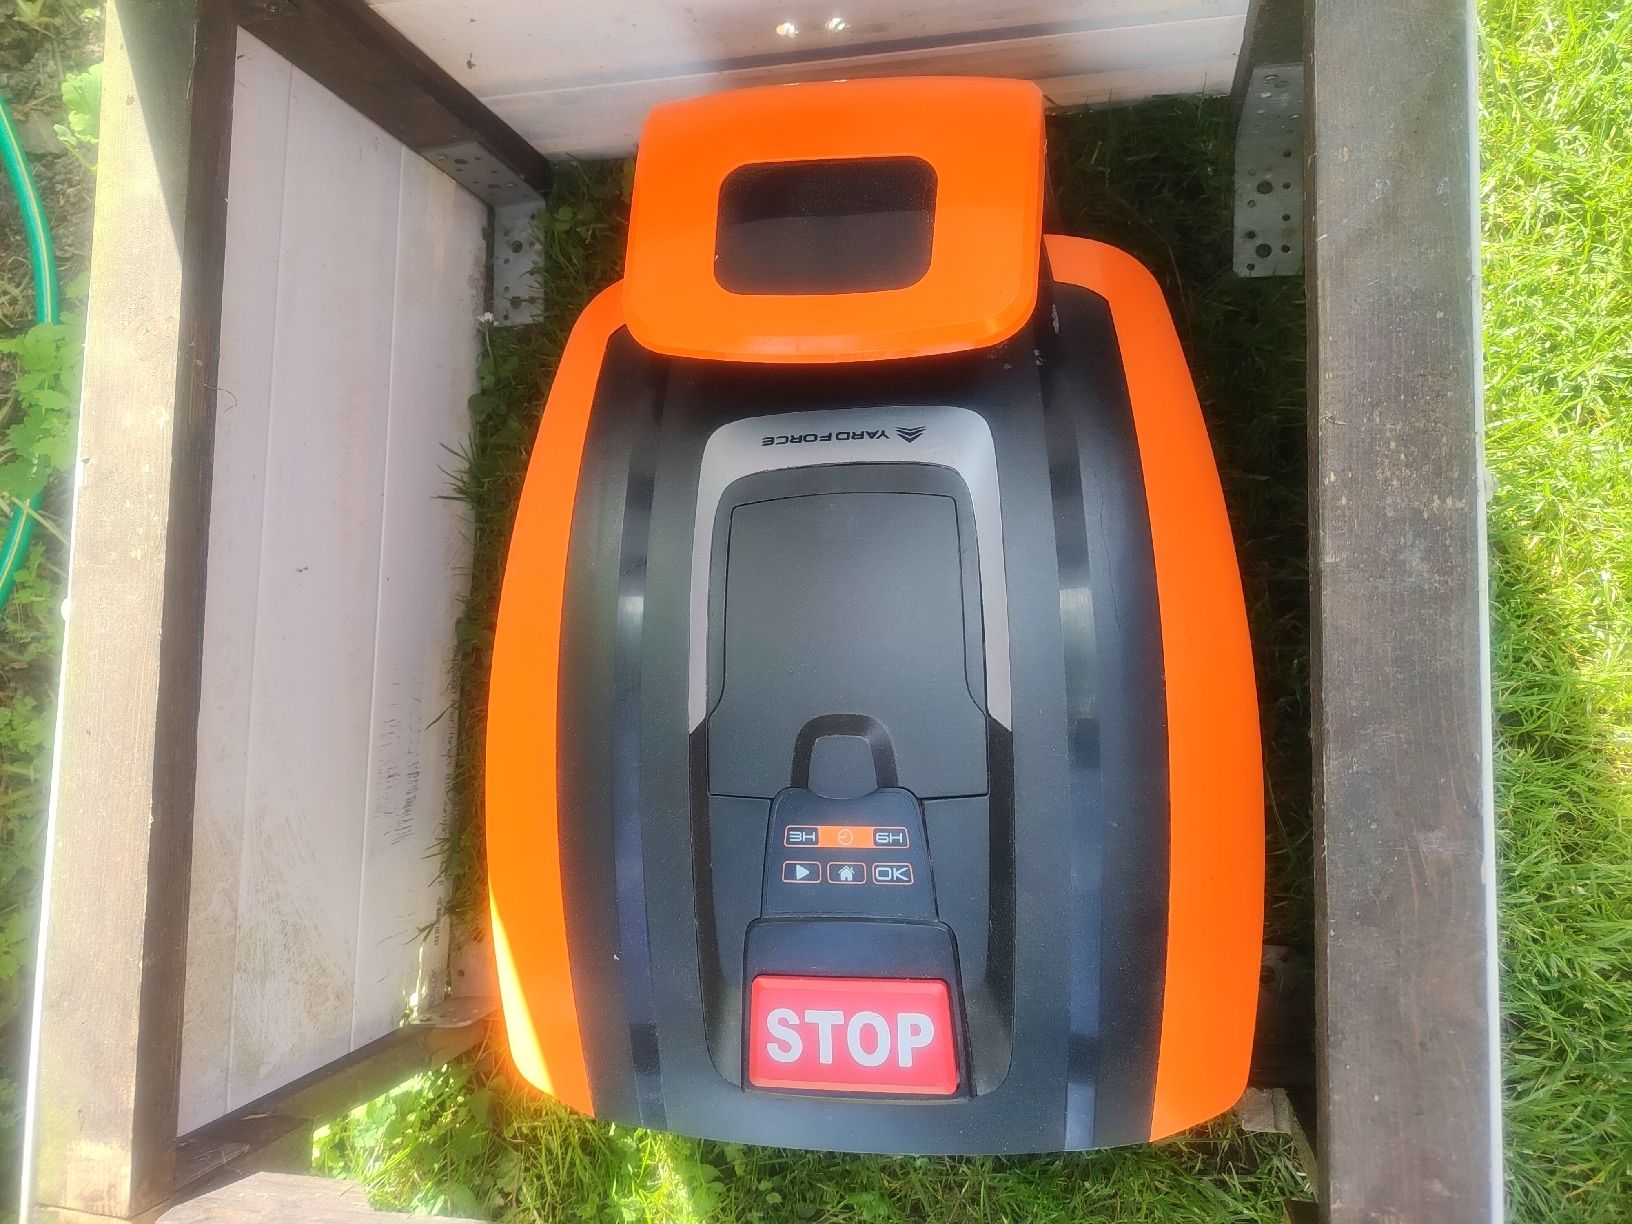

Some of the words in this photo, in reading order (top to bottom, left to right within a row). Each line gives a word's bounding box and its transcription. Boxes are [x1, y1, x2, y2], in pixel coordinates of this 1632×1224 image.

[760, 432, 832, 447] FORCE
[836, 429, 890, 441] YARD
[789, 831, 816, 842] 3H
[875, 832, 903, 844] 6H
[875, 867, 910, 881] OK
[766, 1007, 935, 1067] STOP
